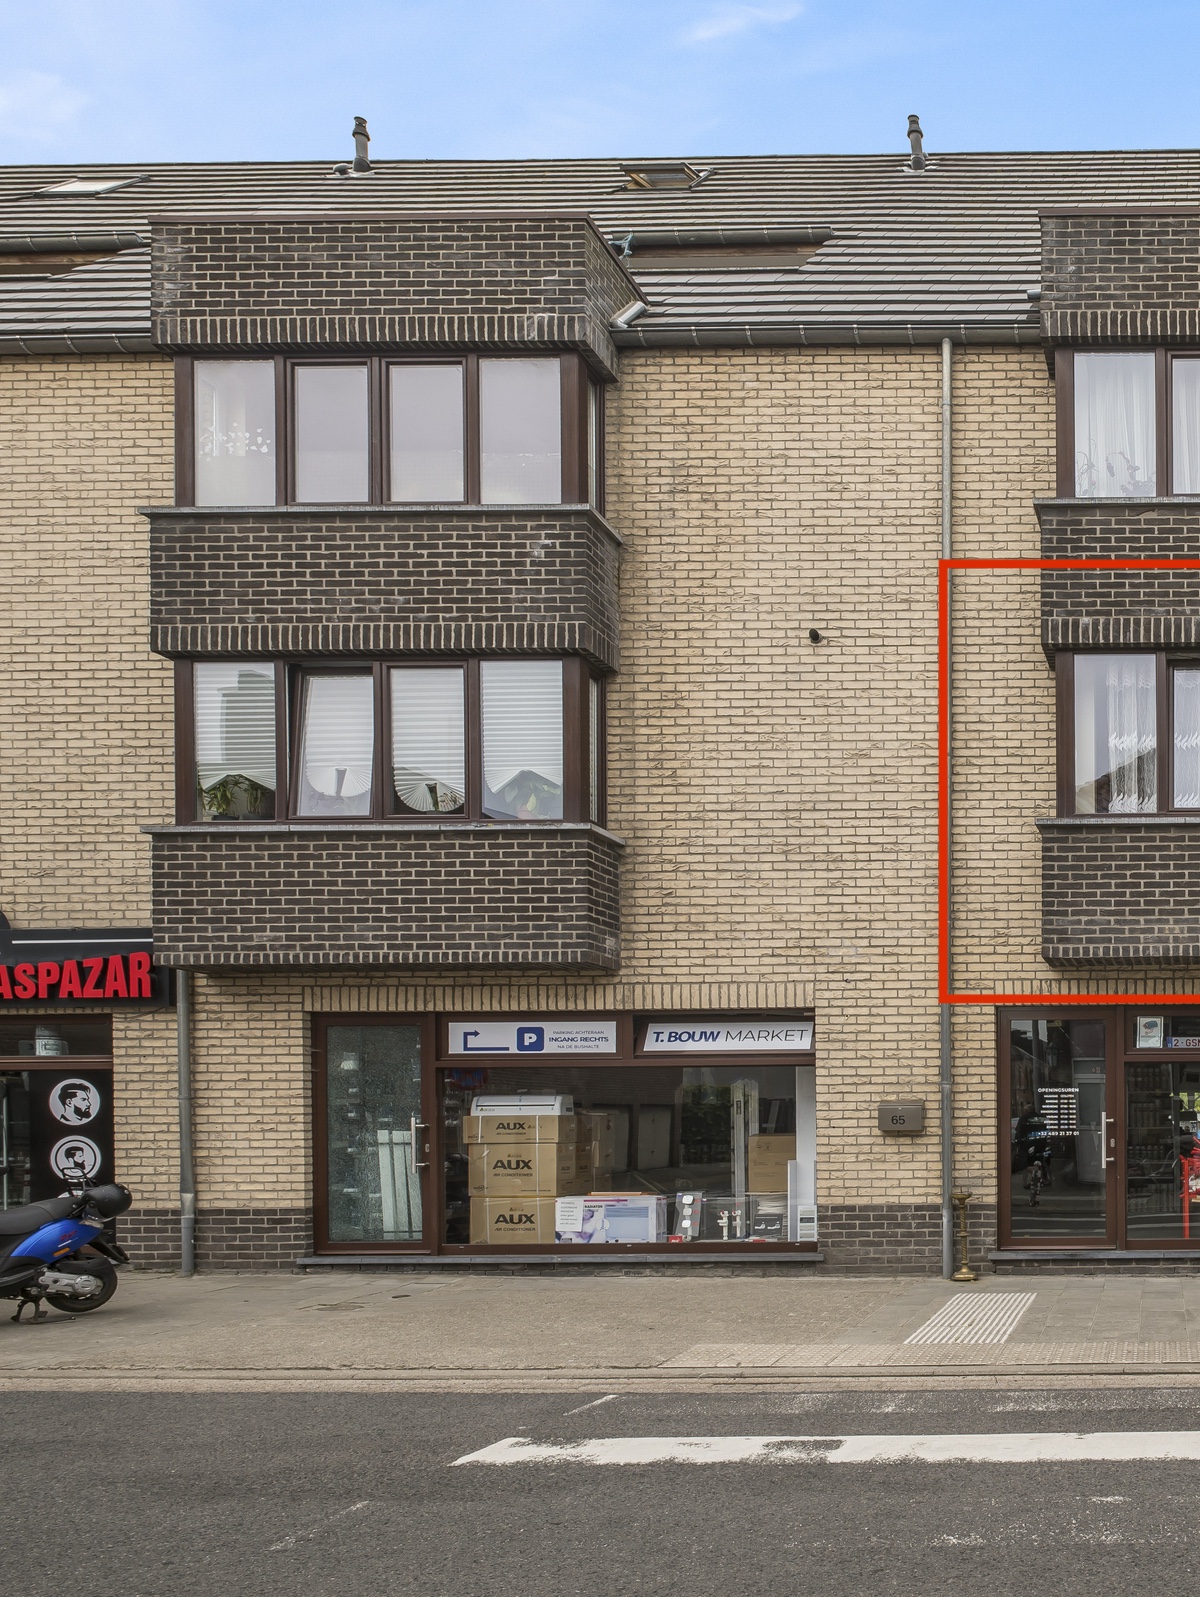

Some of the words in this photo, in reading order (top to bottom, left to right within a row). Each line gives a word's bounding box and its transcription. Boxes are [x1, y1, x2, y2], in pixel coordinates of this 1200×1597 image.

[524, 1033, 538, 1046] P
[653, 1031, 665, 1043] T.
[667, 1031, 721, 1043] BOUW
[724, 1029, 809, 1042] MARKET
[891, 1115, 906, 1125] 65
[495, 1122, 526, 1131] AUX
[492, 1159, 533, 1170] AUX
[494, 1213, 536, 1225] AUX
